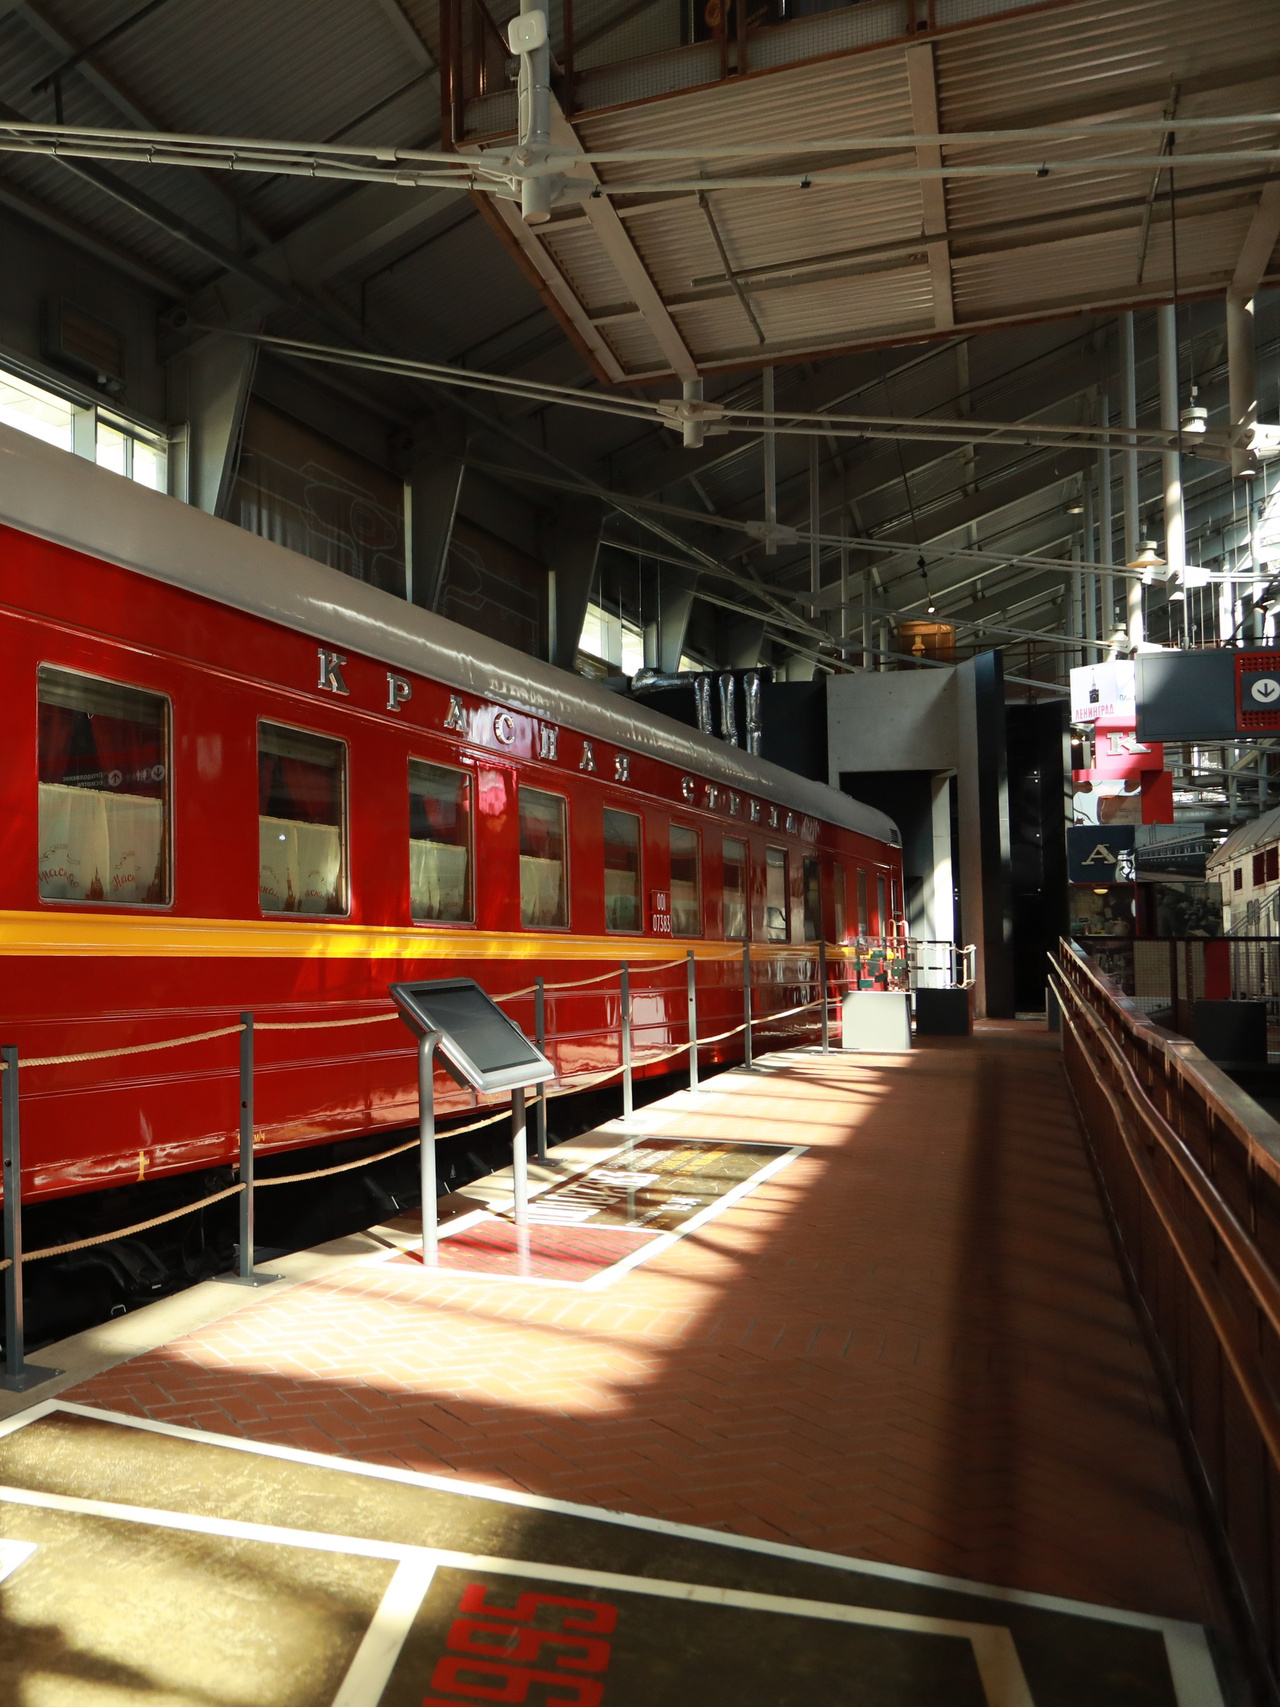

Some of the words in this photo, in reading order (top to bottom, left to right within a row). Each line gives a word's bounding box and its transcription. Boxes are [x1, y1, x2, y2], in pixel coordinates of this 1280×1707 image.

[317, 648, 631, 782] КРАСНАЯ
[681, 776, 798, 834] СТРЕЛА
[1075, 703, 1114, 720] ЛЕНИНГРАД
[653, 914, 670, 932] 07383
[421, 1583, 618, 1707] 995
